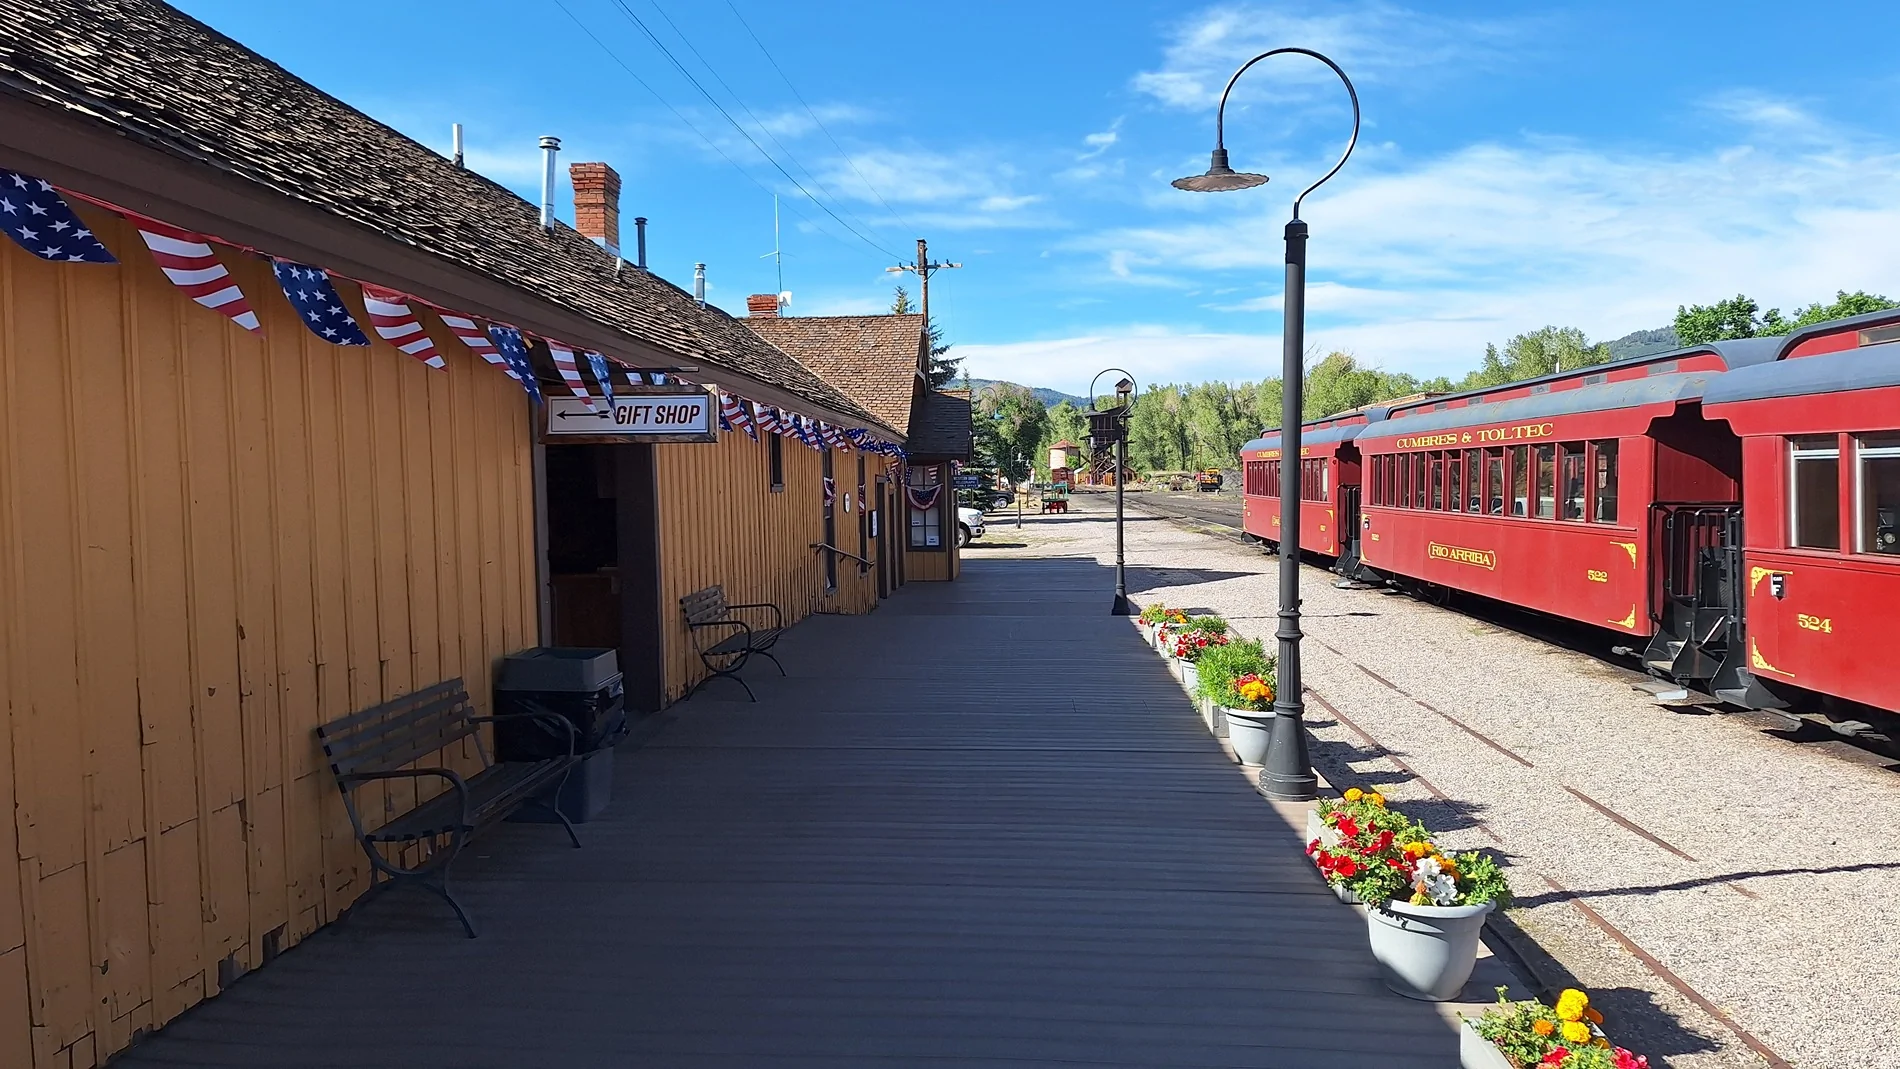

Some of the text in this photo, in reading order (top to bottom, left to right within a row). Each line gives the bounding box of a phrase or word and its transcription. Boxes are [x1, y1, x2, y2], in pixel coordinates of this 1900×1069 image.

[616, 404, 700, 425] GIFT SHOP
[1396, 422, 1554, 449] CUMBRES & TOLTEC
[1431, 545, 1491, 566] RIO ARRIBA
[1587, 569, 1608, 582] 522
[1773, 584, 1782, 596] F
[1798, 613, 1832, 634] 524
